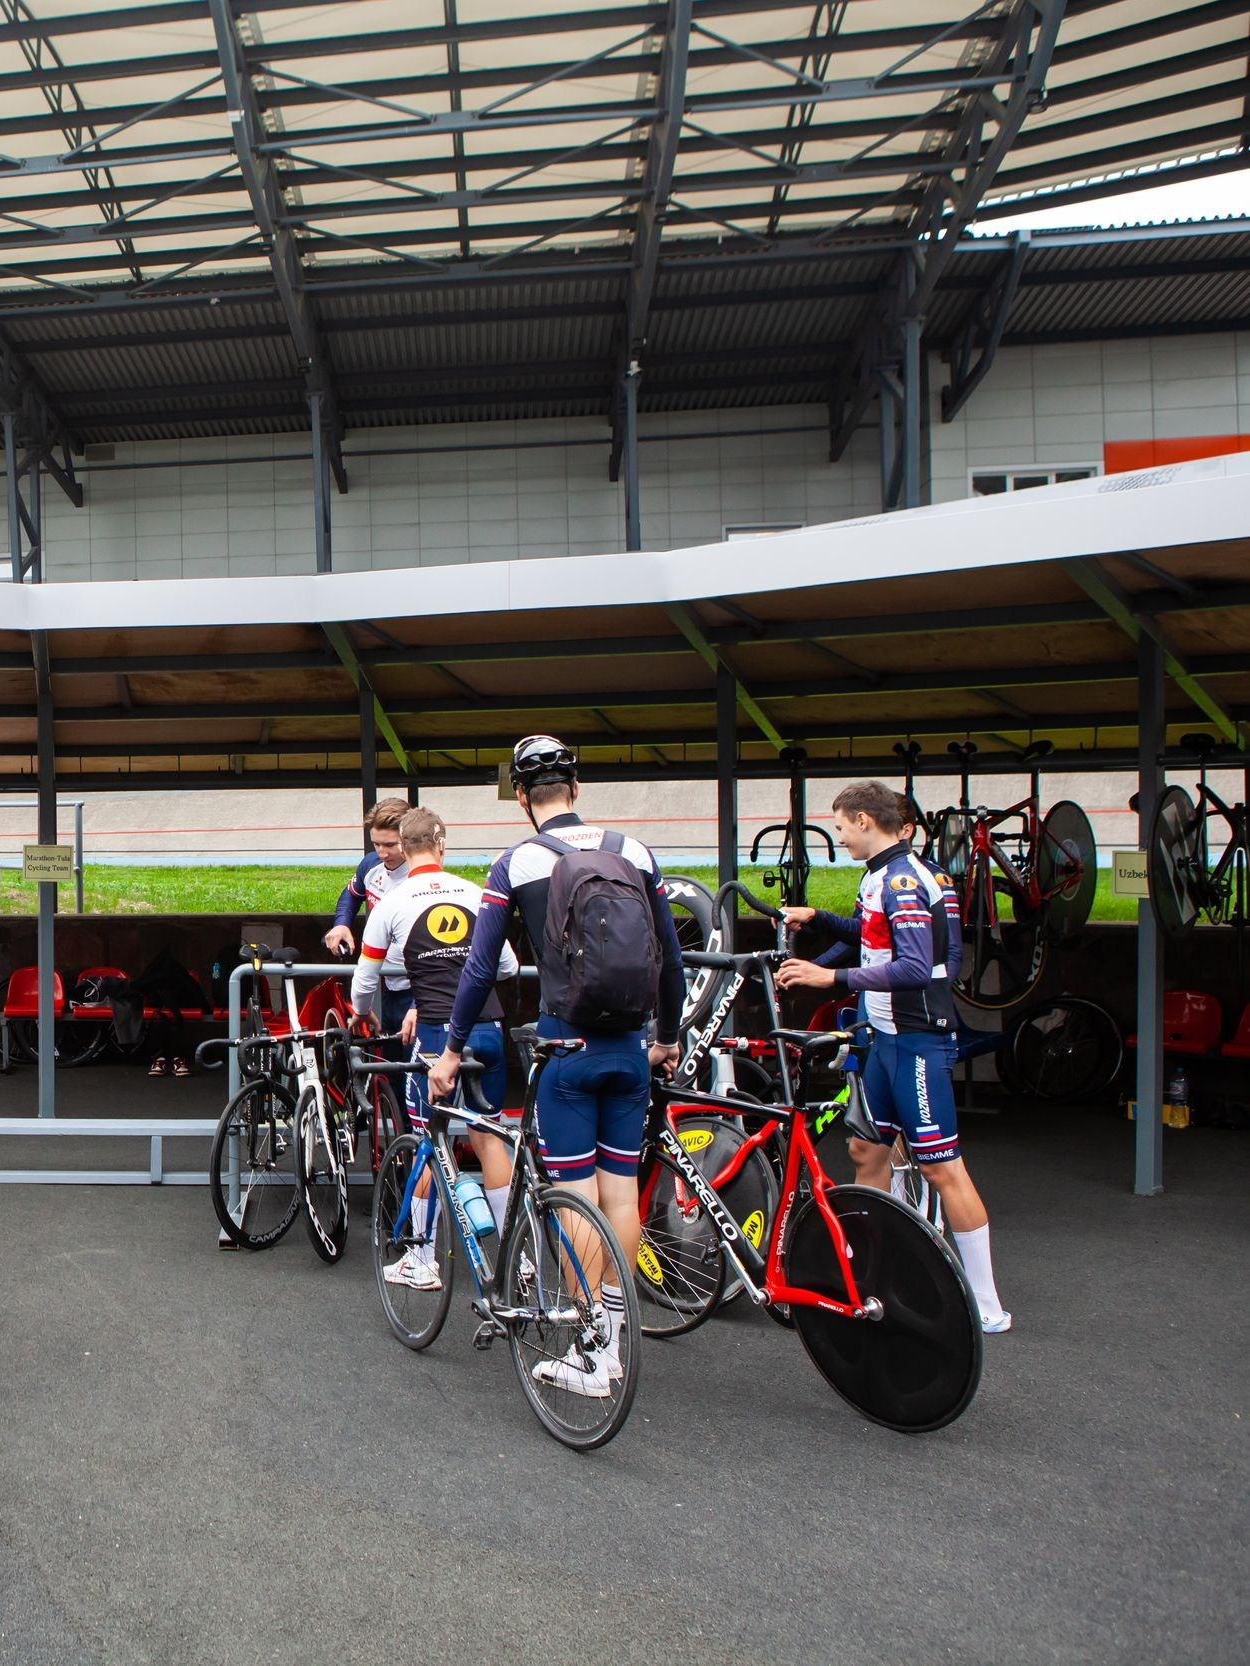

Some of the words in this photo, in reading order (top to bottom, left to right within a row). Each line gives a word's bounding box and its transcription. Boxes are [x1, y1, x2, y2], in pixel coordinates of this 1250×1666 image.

[558, 832, 603, 841] ROZDEN
[26, 854, 71, 862] Marathon-Tula
[27, 864, 51, 872] Cycling
[1118, 868, 1149, 879] Uzbek
[896, 921, 927, 930] BIEMME
[417, 946, 472, 960] MARATHON-T
[684, 971, 745, 1077] PINARELLO
[915, 1055, 932, 1125] VOZROZDENIE
[681, 1135, 705, 1147] AVIC
[916, 1148, 955, 1161] BIEMME
[659, 1130, 739, 1241] PINARELLO
[249, 1195, 299, 1244] CAMPAGN
[776, 1191, 796, 1256] PINARELLO
